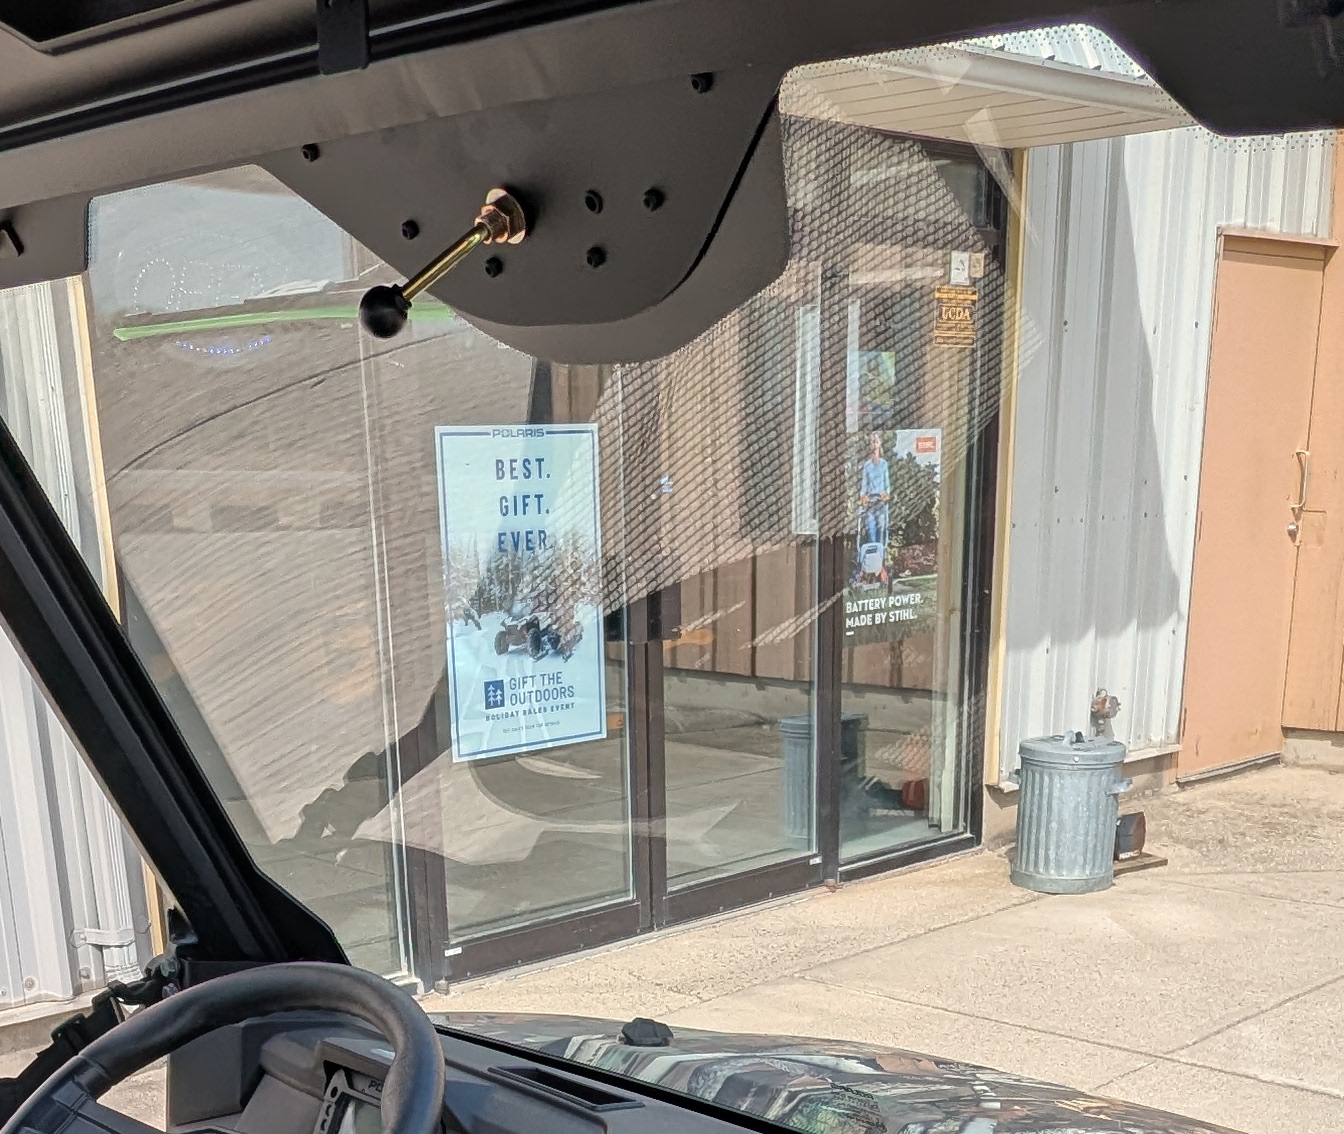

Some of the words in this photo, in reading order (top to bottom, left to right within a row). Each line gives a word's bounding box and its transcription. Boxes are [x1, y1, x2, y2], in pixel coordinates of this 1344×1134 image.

[492, 428, 545, 439] POLARIS
[495, 457, 551, 481] BEST.
[499, 493, 550, 517] GIFT.
[845, 597, 887, 614] BATTERY
[888, 593, 924, 608] POWER.
[845, 613, 873, 629] MADE
[874, 611, 887, 625] BY
[888, 608, 918, 623] STIHL.
[509, 675, 536, 691] GIFT
[539, 671, 563, 687] THE
[509, 685, 575, 707] OUTDOORS
[485, 710, 520, 722] HOLIDAY
